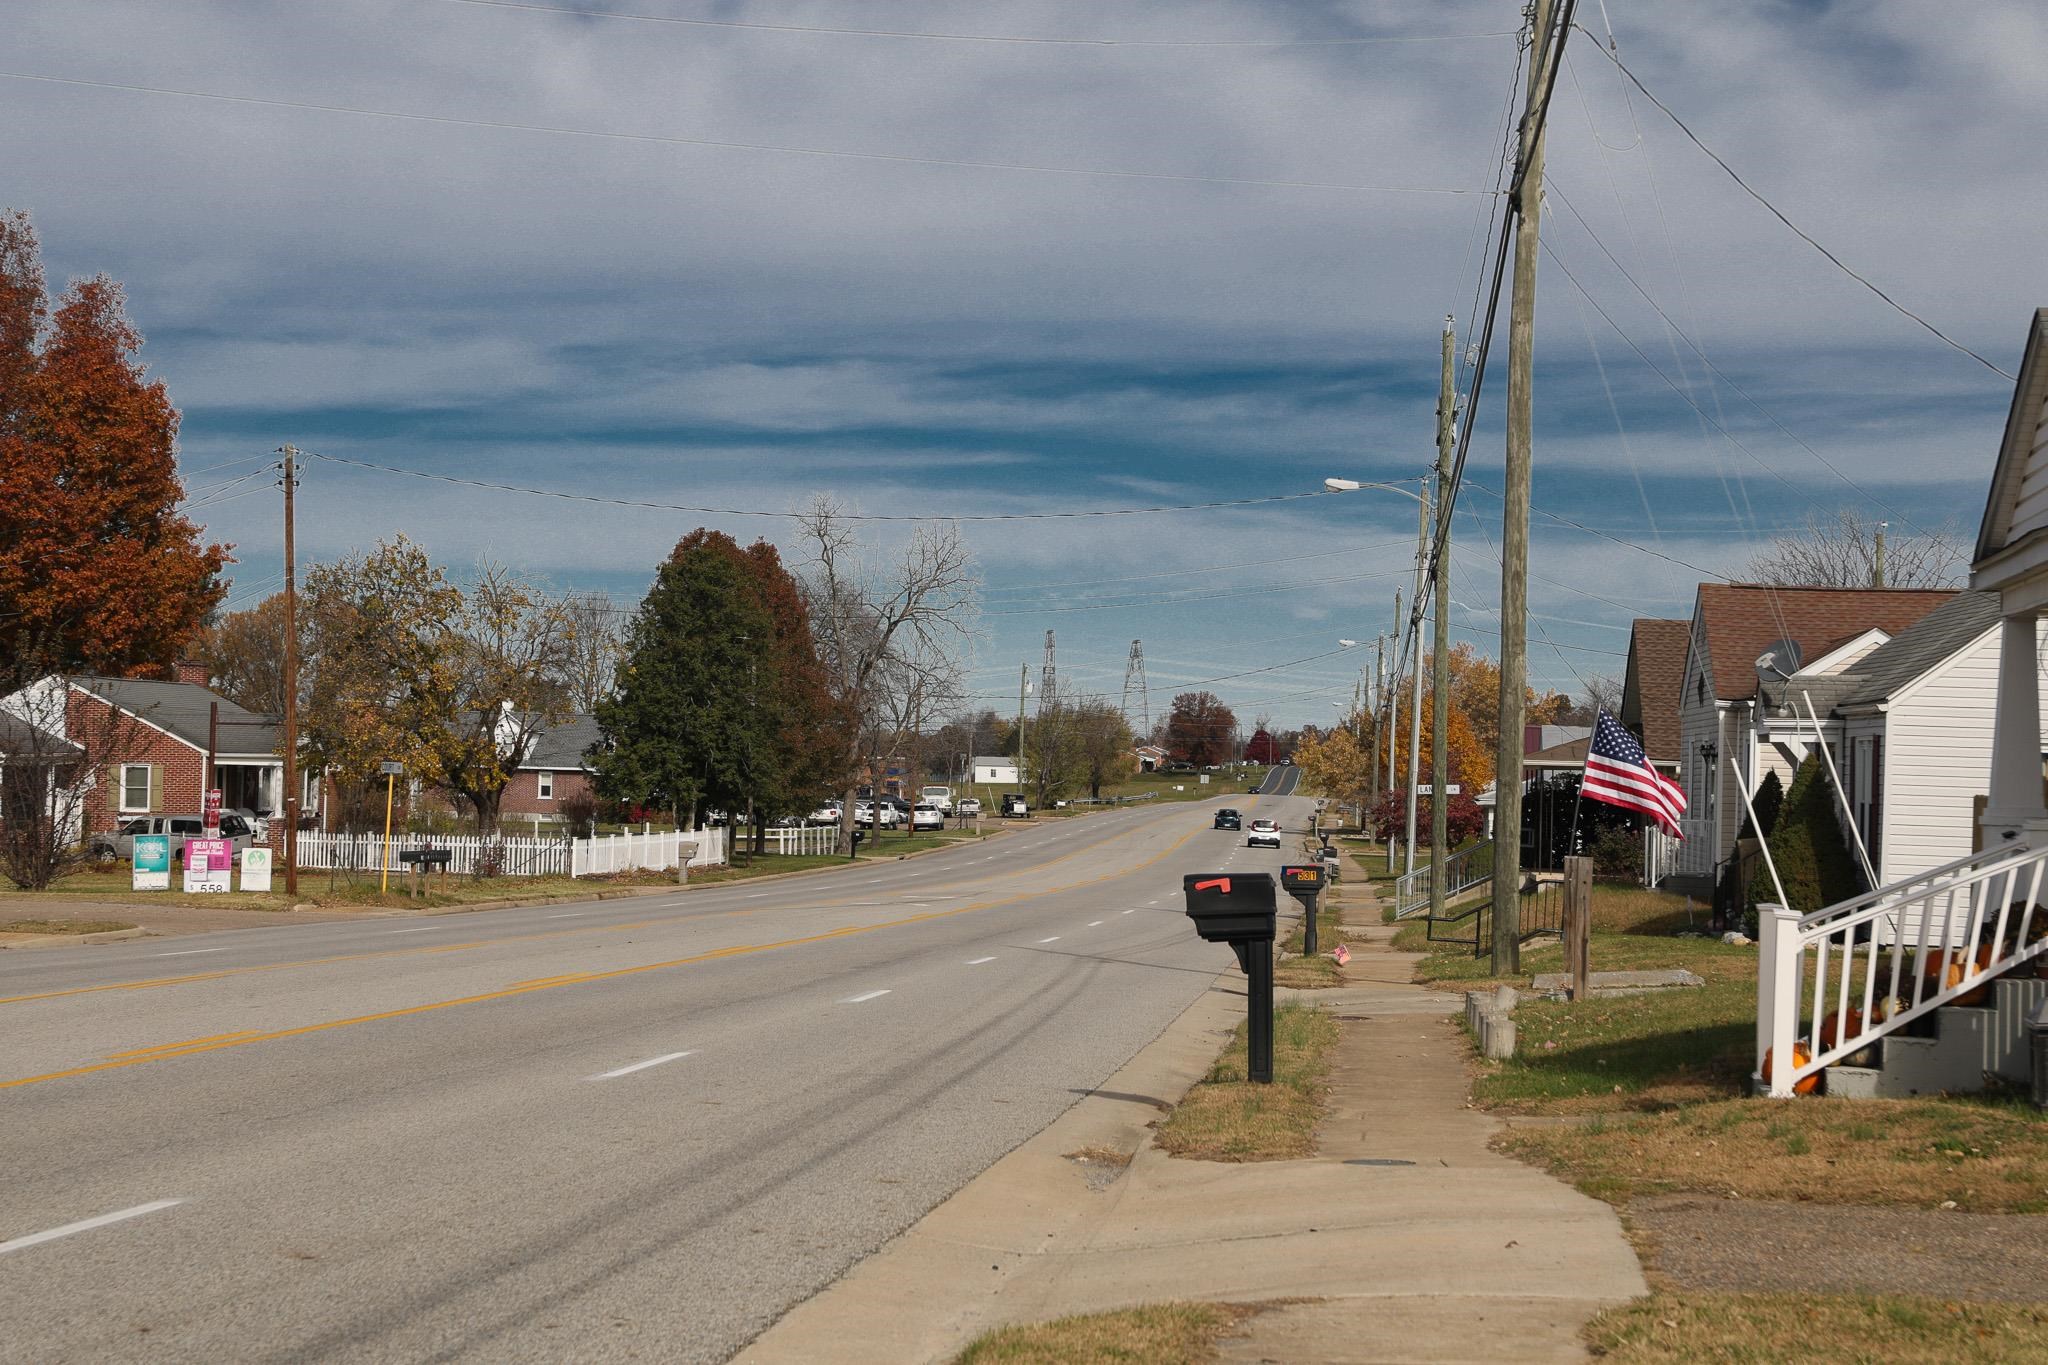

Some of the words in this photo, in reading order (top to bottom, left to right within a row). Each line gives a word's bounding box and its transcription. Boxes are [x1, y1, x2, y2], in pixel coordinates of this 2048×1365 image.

[136, 842, 166, 854] KOOL
[192, 841, 208, 849] GREAT
[209, 841, 224, 849] PRICE
[1298, 871, 1316, 880] 531
